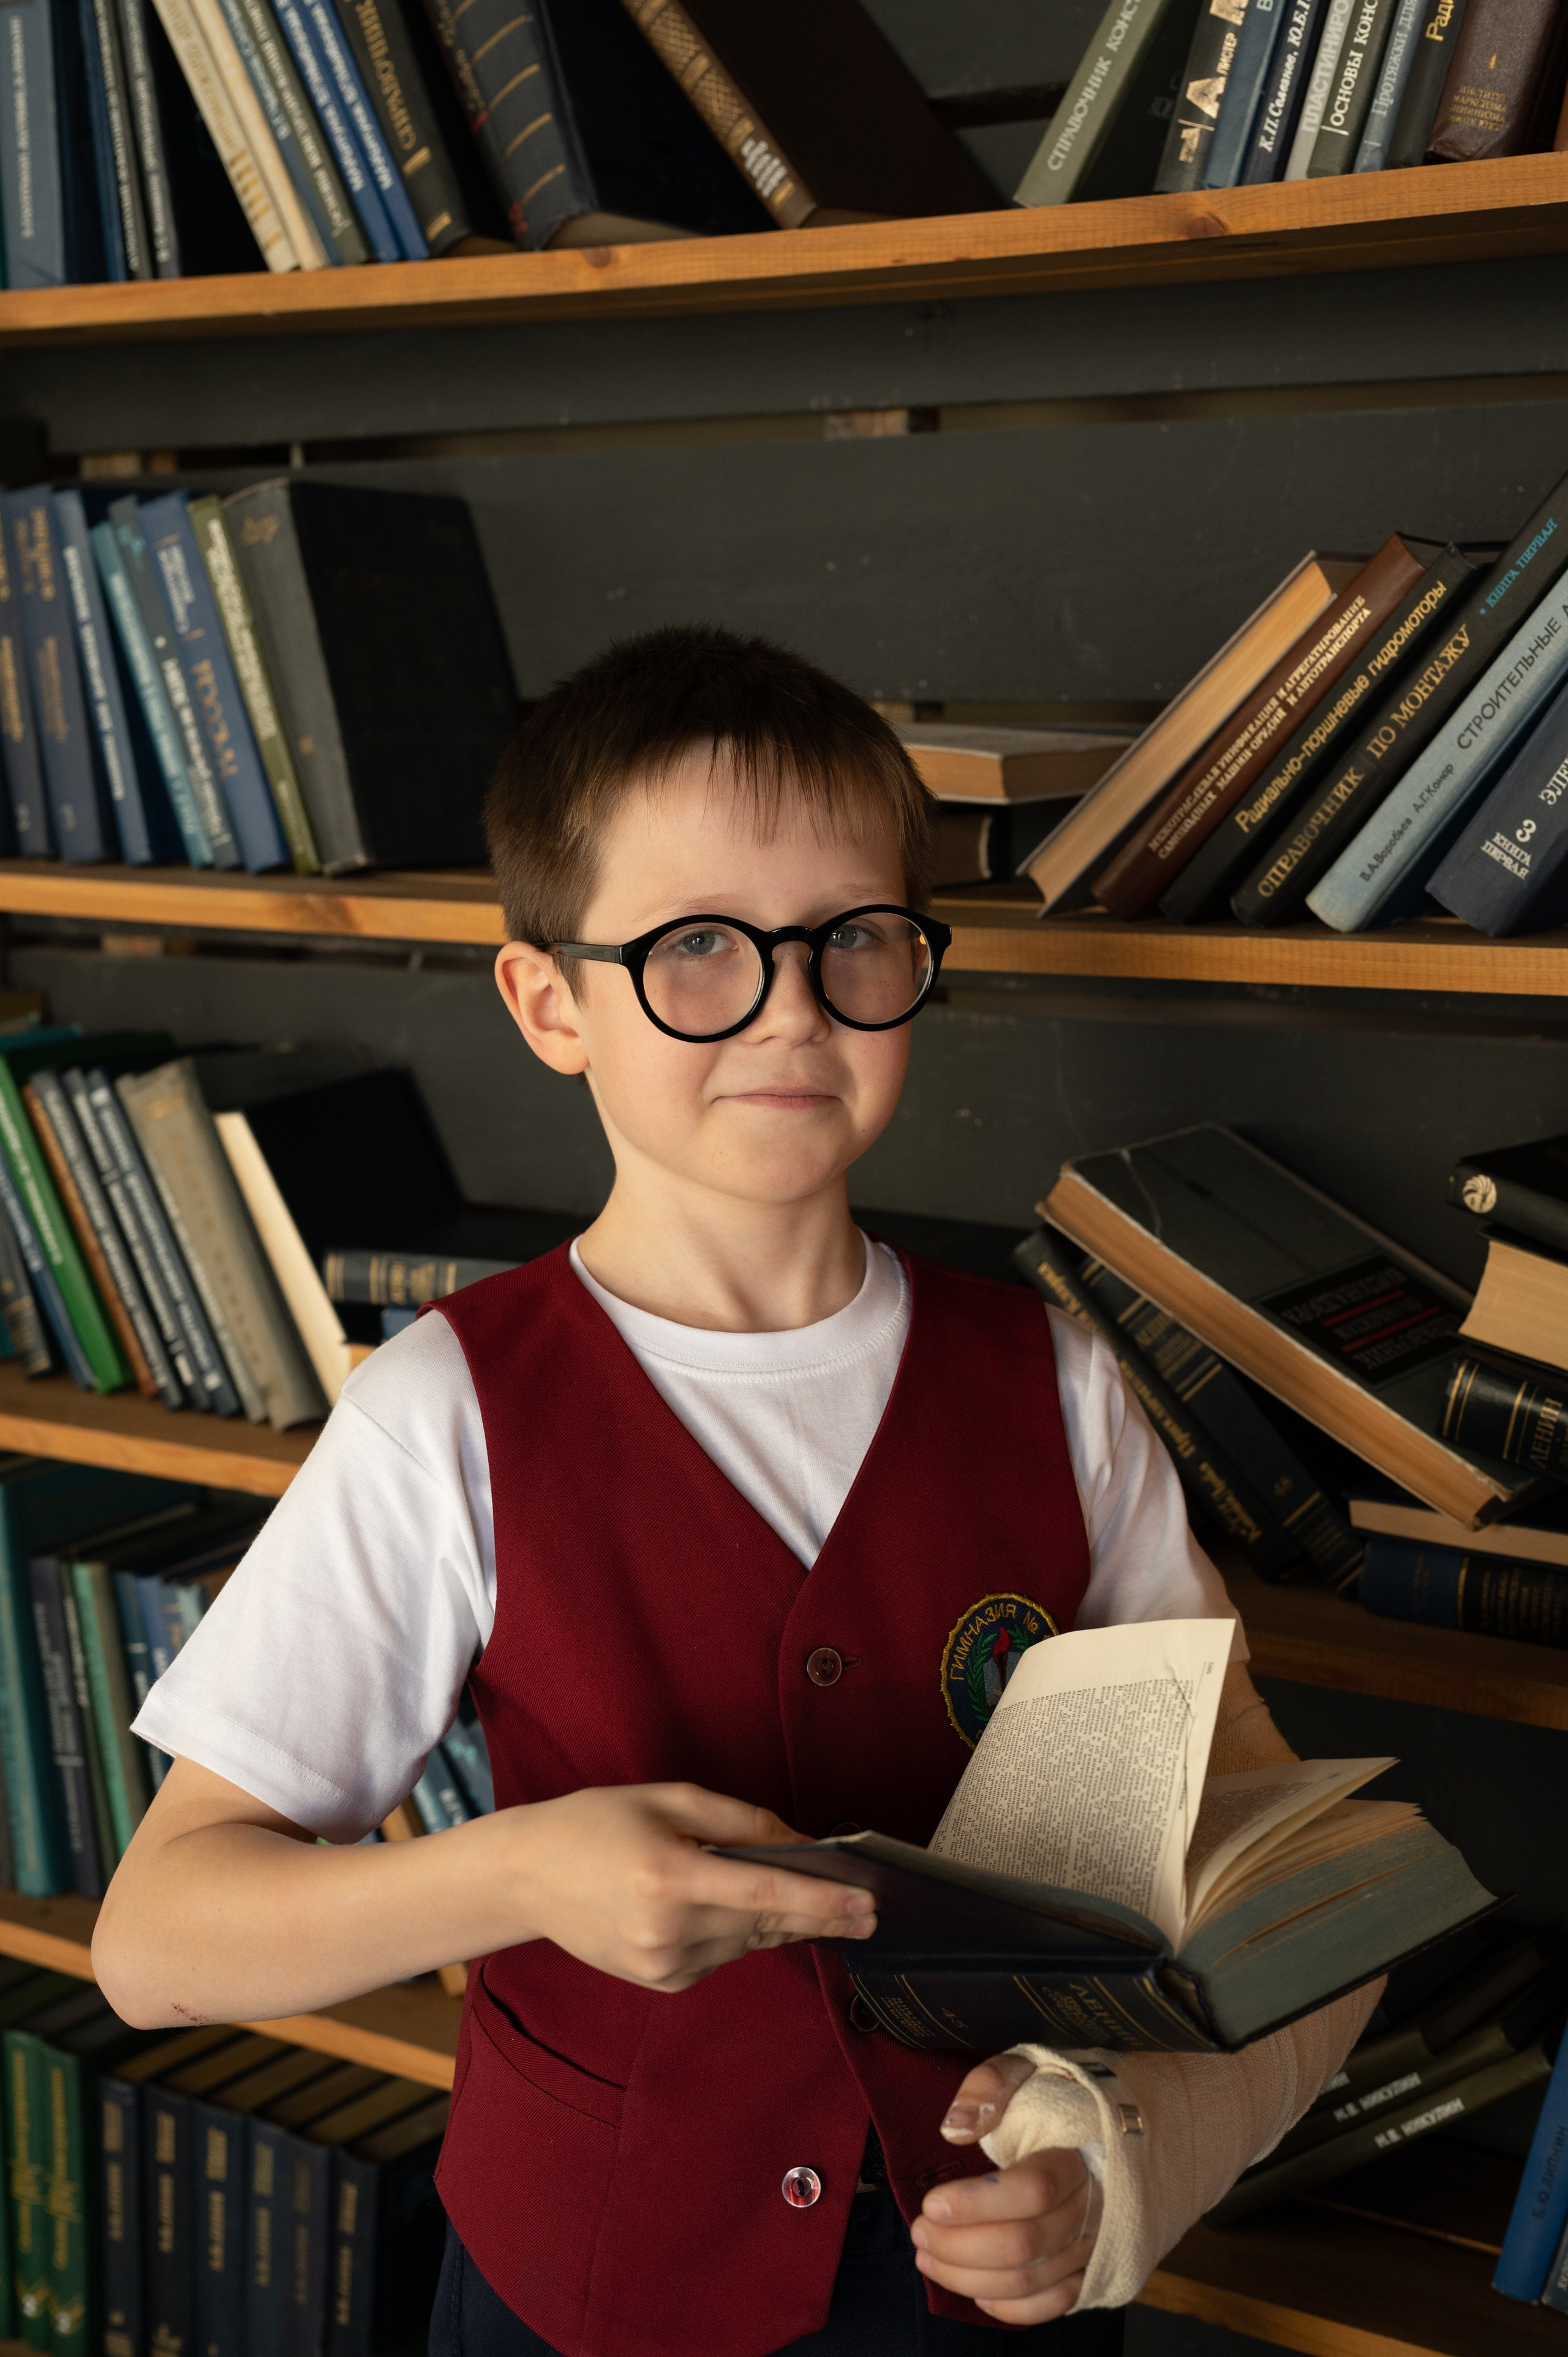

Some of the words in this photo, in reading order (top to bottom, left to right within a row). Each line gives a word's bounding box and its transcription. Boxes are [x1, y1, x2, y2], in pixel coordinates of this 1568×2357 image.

[1047, 55, 1112, 172] СПРАВОЧНИК
[1105, 0, 1142, 53] КОНС
[1330, 50, 1363, 127] ОСНОВЫ
[1371, 29, 1409, 117] Протяжки
[1484, 567, 1520, 608] КНИГА
[1520, 516, 1559, 570] ПЕРВАЯ
[1234, 674, 1371, 833] Радиально-поршневые
[1367, 579, 1448, 677] гидромоторы
[1457, 616, 1562, 751] СТРОИТЕЛЬНЫЕ
[1257, 765, 1367, 901] СПРАВОЧНИК
[1365, 726, 1399, 762] ПО
[1395, 622, 1474, 729] МОНТАЖУ
[1480, 839, 1530, 881] ПЕРВАЯ
[1491, 831, 1532, 868] КНИГА
[1526, 1396, 1564, 1469] ЛЕНИН
[949, 1604, 1017, 1681] ГИМНАЗИЯ
[1022, 1612, 1039, 1634] №
